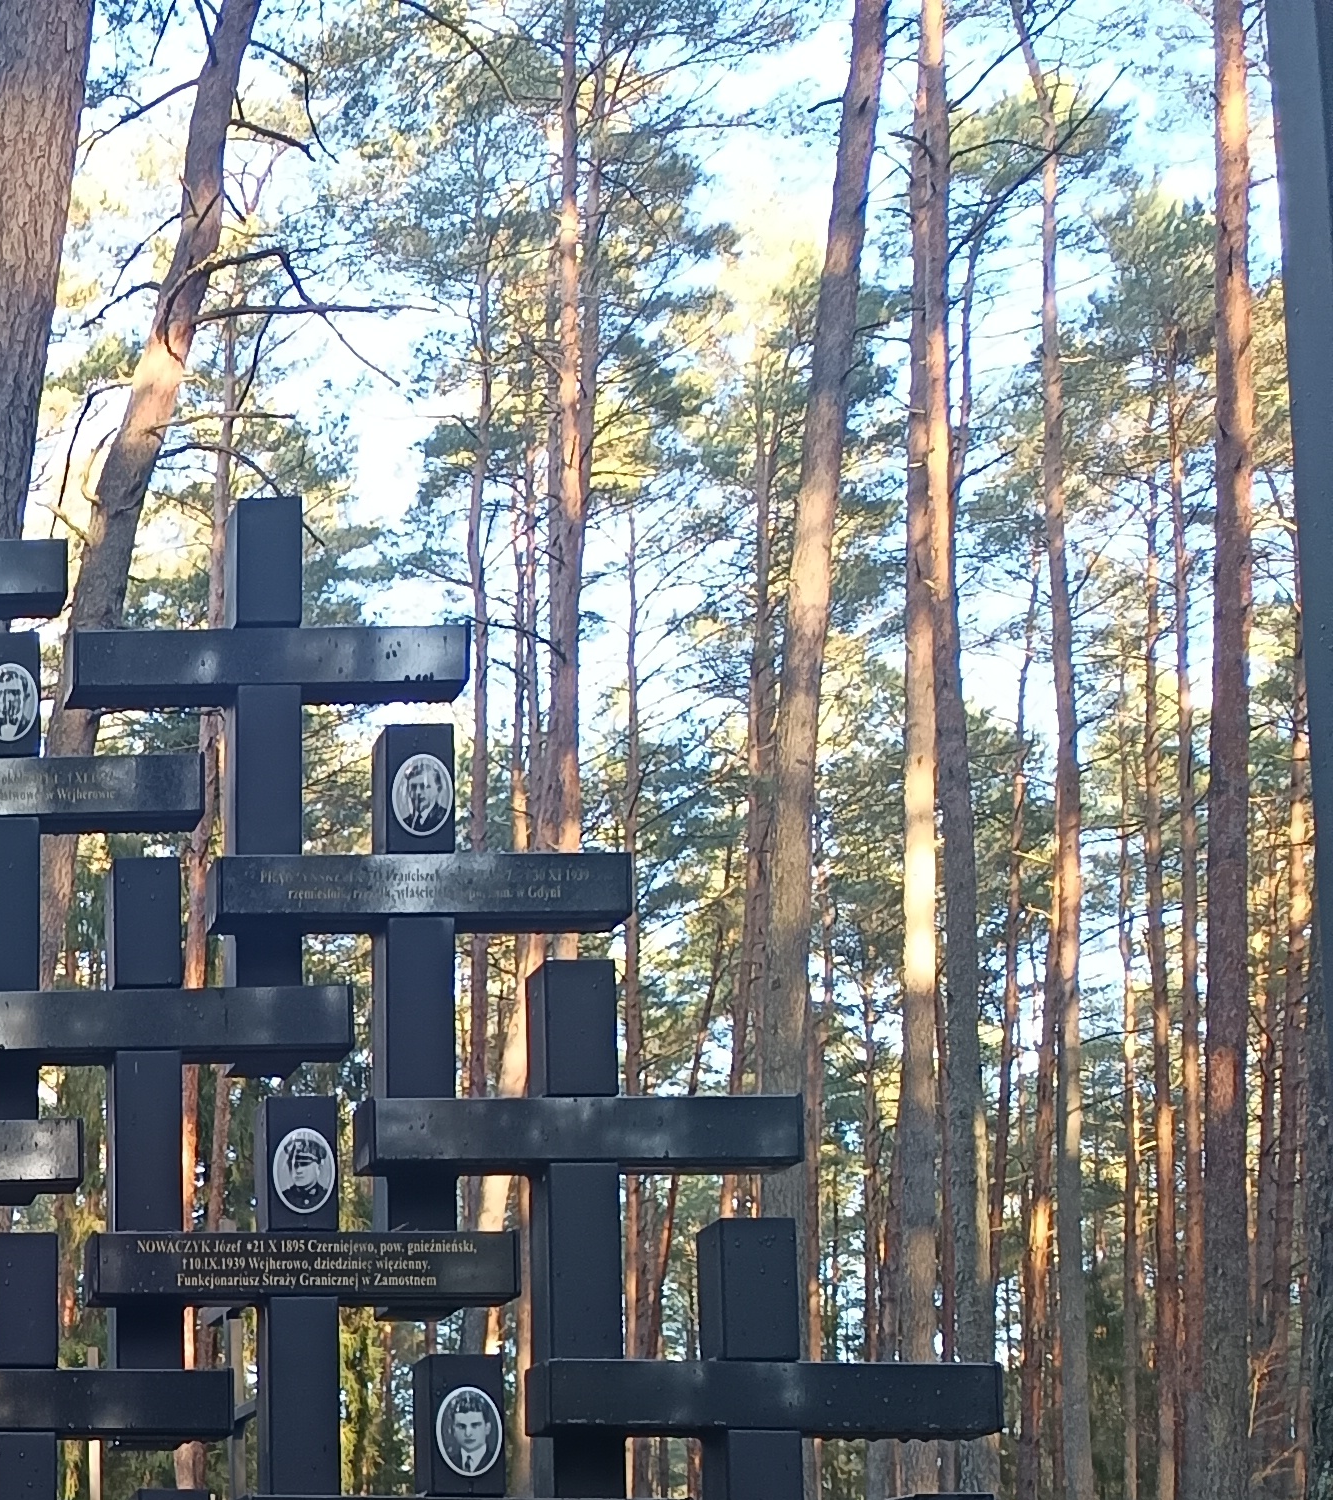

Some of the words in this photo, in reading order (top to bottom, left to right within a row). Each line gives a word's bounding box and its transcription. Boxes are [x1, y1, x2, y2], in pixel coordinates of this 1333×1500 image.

[137, 1240, 210, 1253] NOWACZYK
[213, 1239, 242, 1253] Józef
[281, 1240, 305, 1252] 1895
[308, 1239, 377, 1255] Czerniejewo,
[380, 1243, 404, 1255] pow.
[408, 1239, 477, 1255] gnieźnieński,
[249, 1257, 311, 1272] Wejherowo,
[314, 1257, 372, 1270] dziedziniec
[375, 1257, 430, 1272] więzienny.
[177, 1273, 259, 1289] Funkcjonariusz
[262, 1273, 296, 1288] Straży
[300, 1273, 359, 1290] Granicznej
[374, 1273, 436, 1286] Zamostnem
